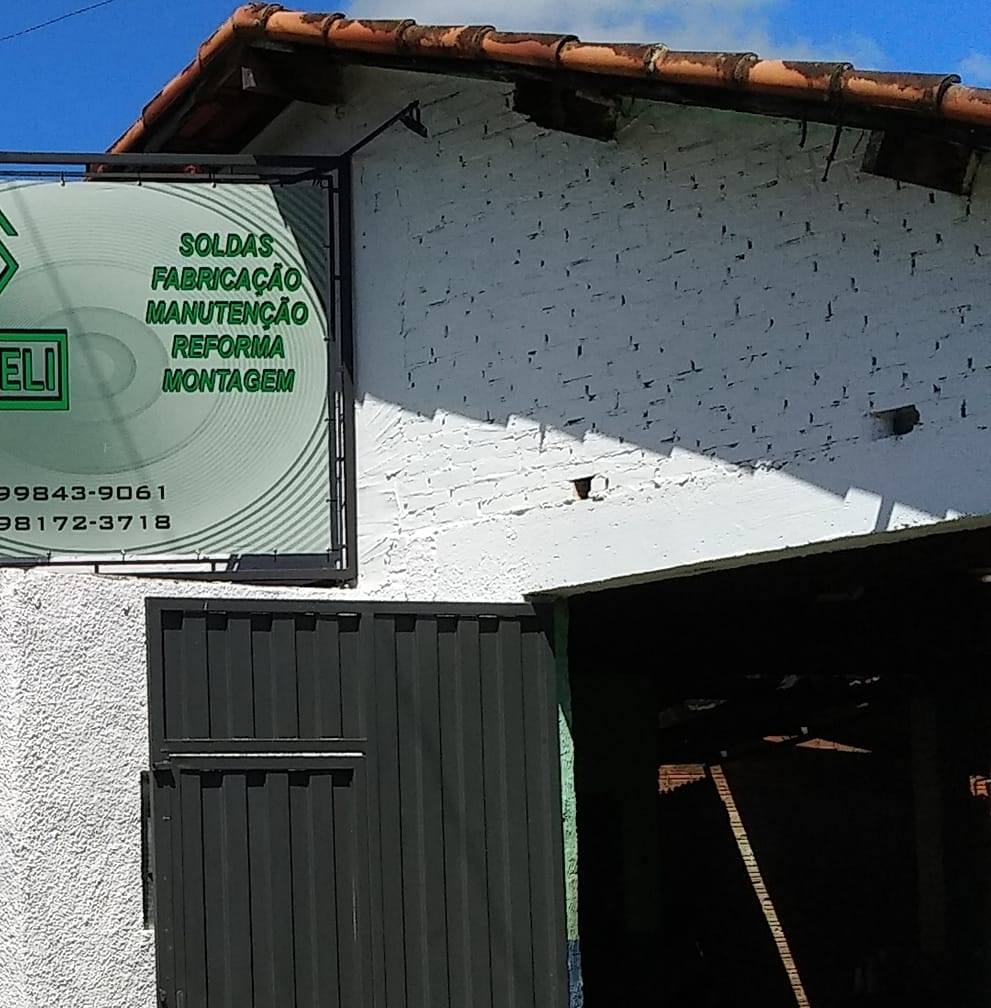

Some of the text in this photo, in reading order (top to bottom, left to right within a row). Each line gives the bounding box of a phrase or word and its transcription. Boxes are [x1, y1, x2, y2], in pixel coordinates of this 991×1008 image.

[179, 233, 274, 257] SOLDAS
[151, 263, 302, 296] FABRICAÇÃO
[145, 297, 309, 330] MANUTENÇÃO
[171, 335, 285, 359] REFORMA
[162, 369, 296, 393] MONTAGEM
